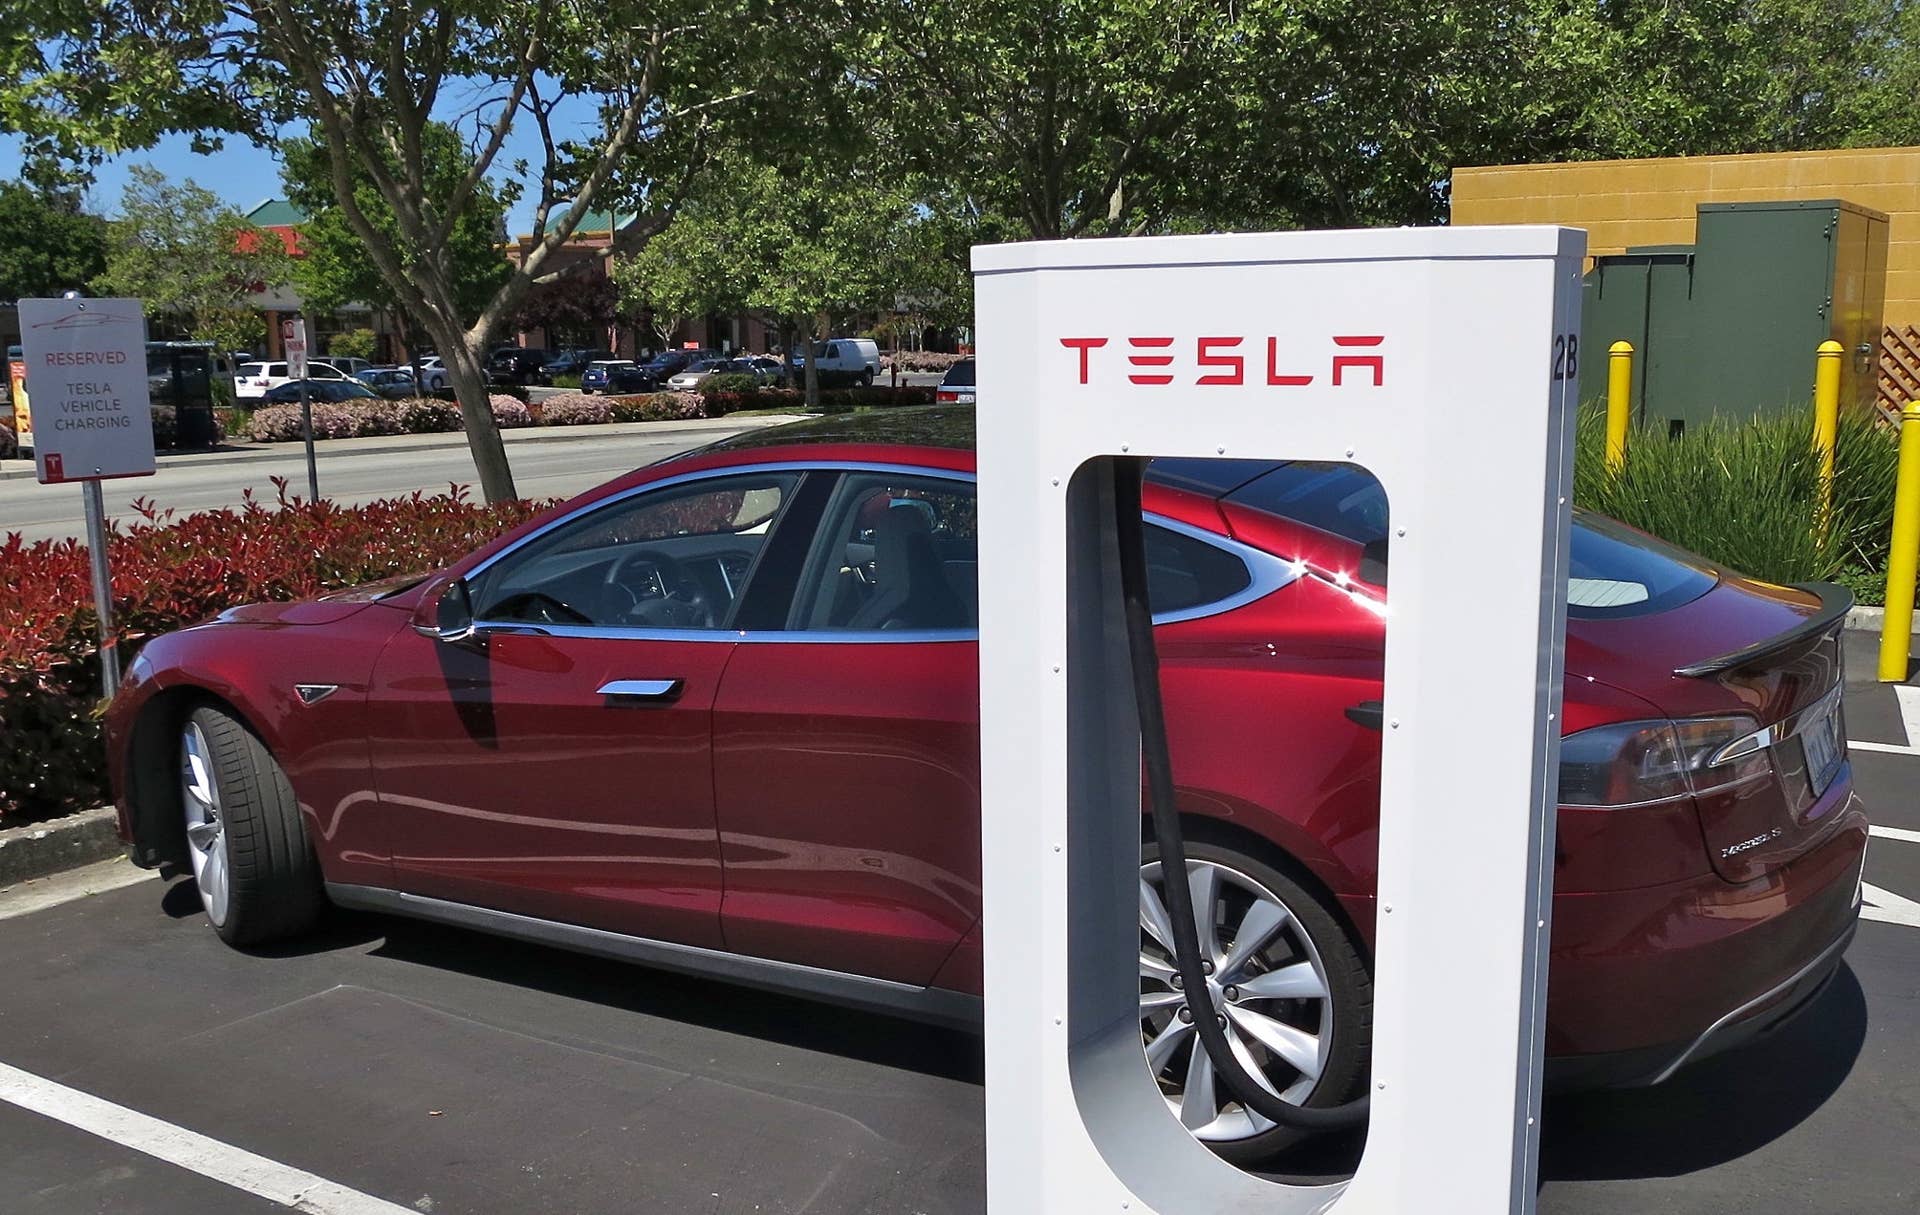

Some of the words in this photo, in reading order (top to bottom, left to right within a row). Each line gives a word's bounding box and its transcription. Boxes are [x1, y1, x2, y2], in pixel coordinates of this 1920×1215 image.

[46, 351, 126, 366] RESERVED
[1060, 335, 1385, 387] TESLA
[1554, 334, 1577, 380] 2B
[66, 382, 112, 395] TESLA
[60, 399, 121, 413] VEHICLE
[55, 416, 130, 431] CHARGING
